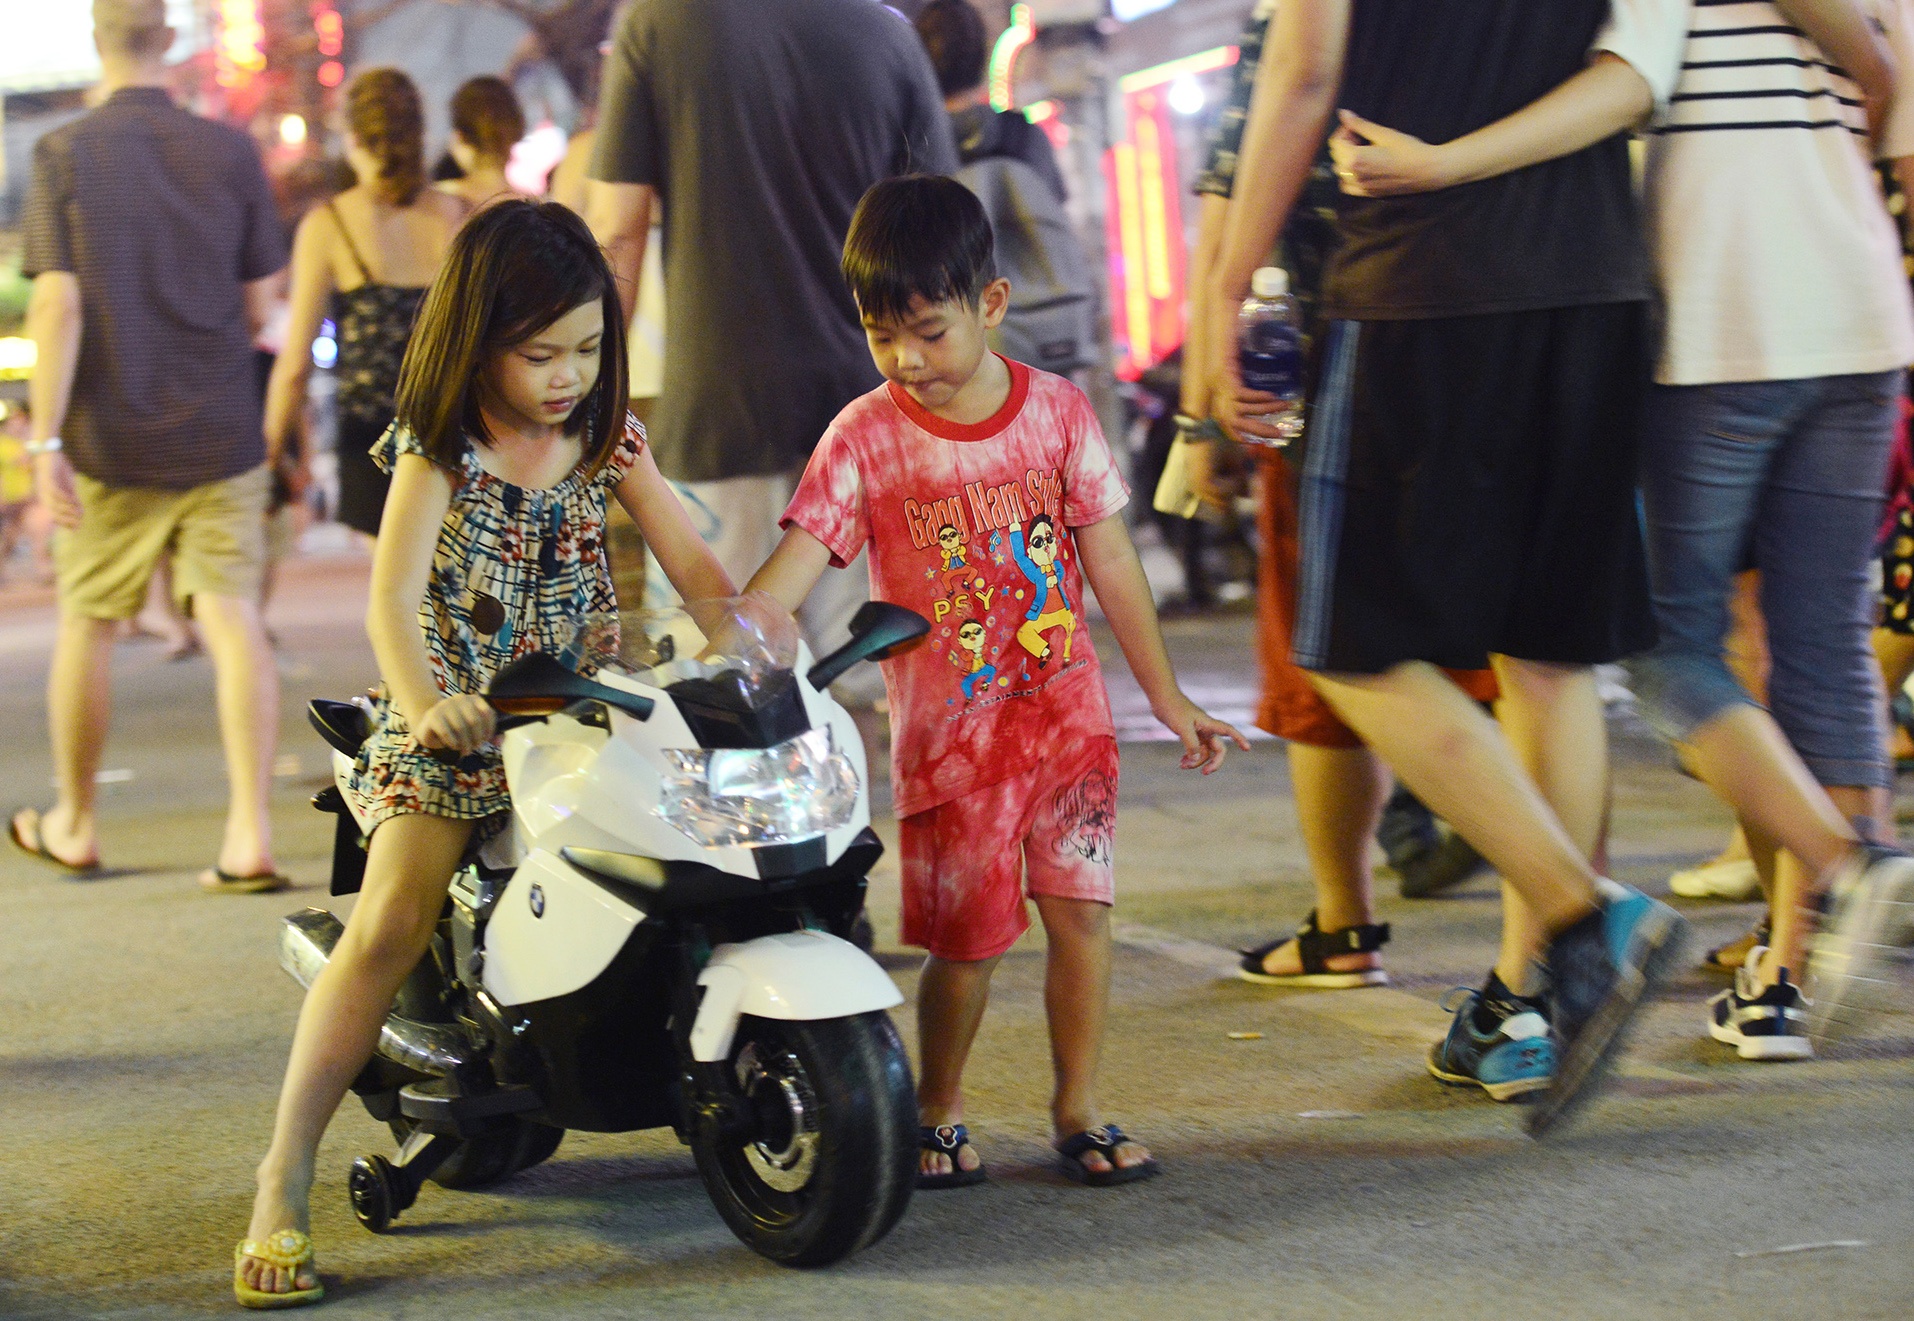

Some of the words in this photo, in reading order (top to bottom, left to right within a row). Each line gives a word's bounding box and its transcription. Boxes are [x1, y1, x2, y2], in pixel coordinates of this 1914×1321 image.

[904, 498, 971, 550] Gang
[965, 481, 1028, 534] Nam
[933, 585, 995, 624] PSY
